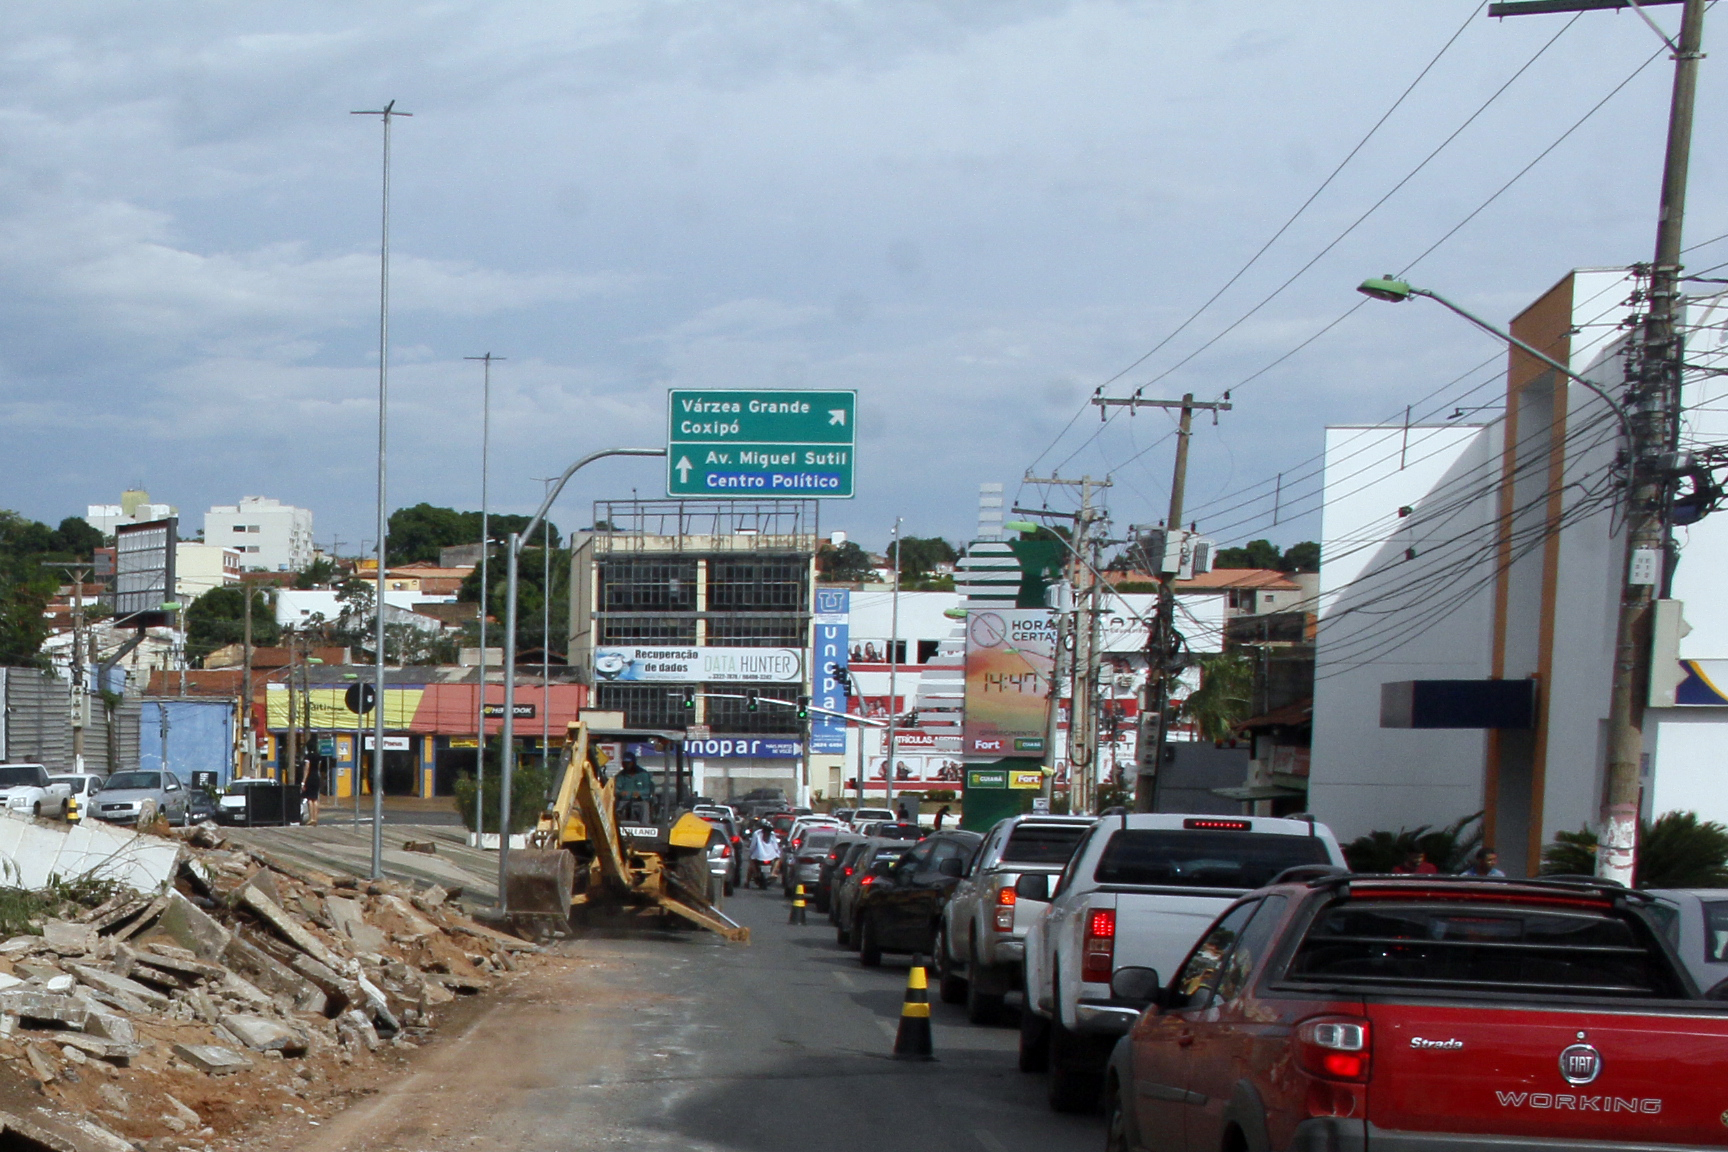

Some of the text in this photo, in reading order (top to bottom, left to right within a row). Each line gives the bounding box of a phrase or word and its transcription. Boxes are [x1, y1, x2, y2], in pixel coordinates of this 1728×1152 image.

[681, 398, 810, 413] Várzea Grande
[681, 419, 740, 436] Coxipó
[705, 451, 847, 468] Av. Miguel Sutil
[706, 473, 839, 488] Centro Político
[1012, 620, 1053, 631] HORA
[1012, 632, 1052, 641] CERTA
[635, 649, 699, 660] Recuperação
[644, 663, 688, 673] de dados
[704, 655, 791, 674] DATA HUNTER
[985, 672, 1038, 693] 14:47
[975, 740, 1001, 749] Fort
[1410, 1037, 1464, 1050] Strada
[1569, 1056, 1593, 1073] FIAT
[1495, 1090, 1662, 1114] WORKING
